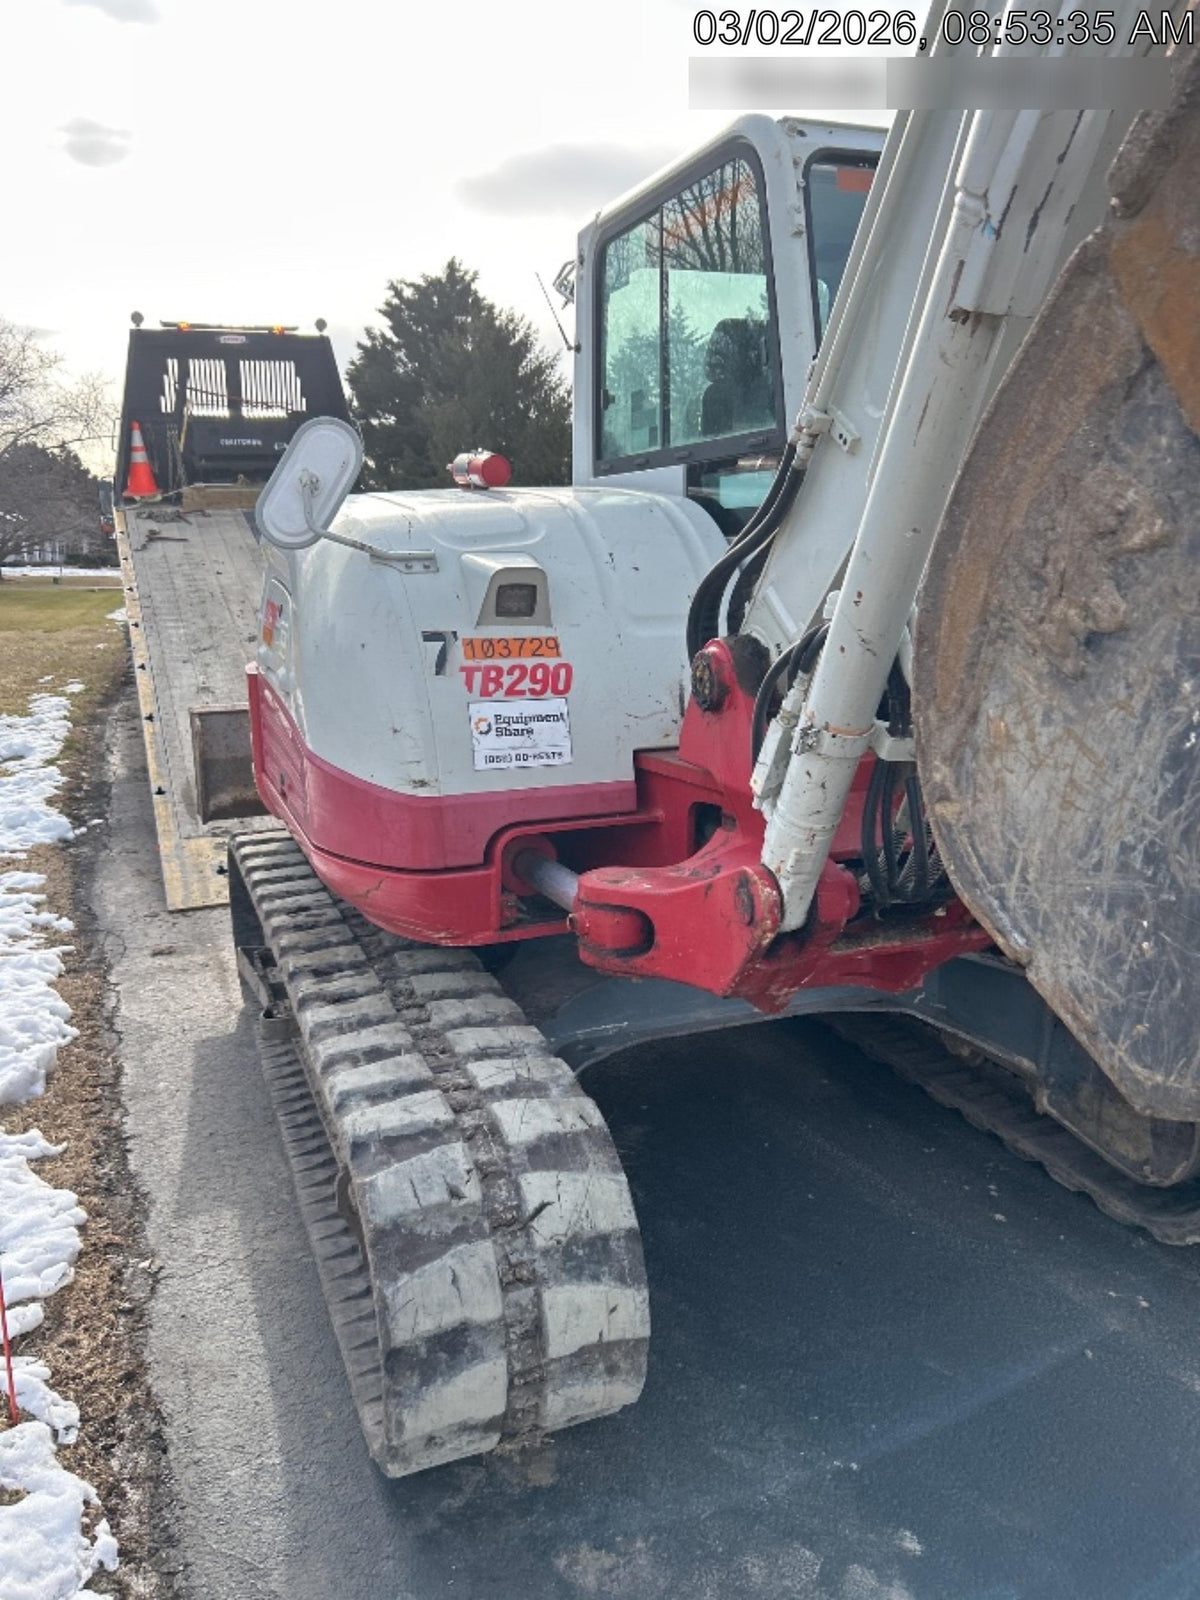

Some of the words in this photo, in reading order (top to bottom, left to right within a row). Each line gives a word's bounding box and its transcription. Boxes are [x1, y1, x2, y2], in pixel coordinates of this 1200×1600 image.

[465, 637, 560, 658] 103729
[459, 663, 573, 697] TB290
[494, 712, 566, 726] Equipment
[495, 727, 534, 737] Share
